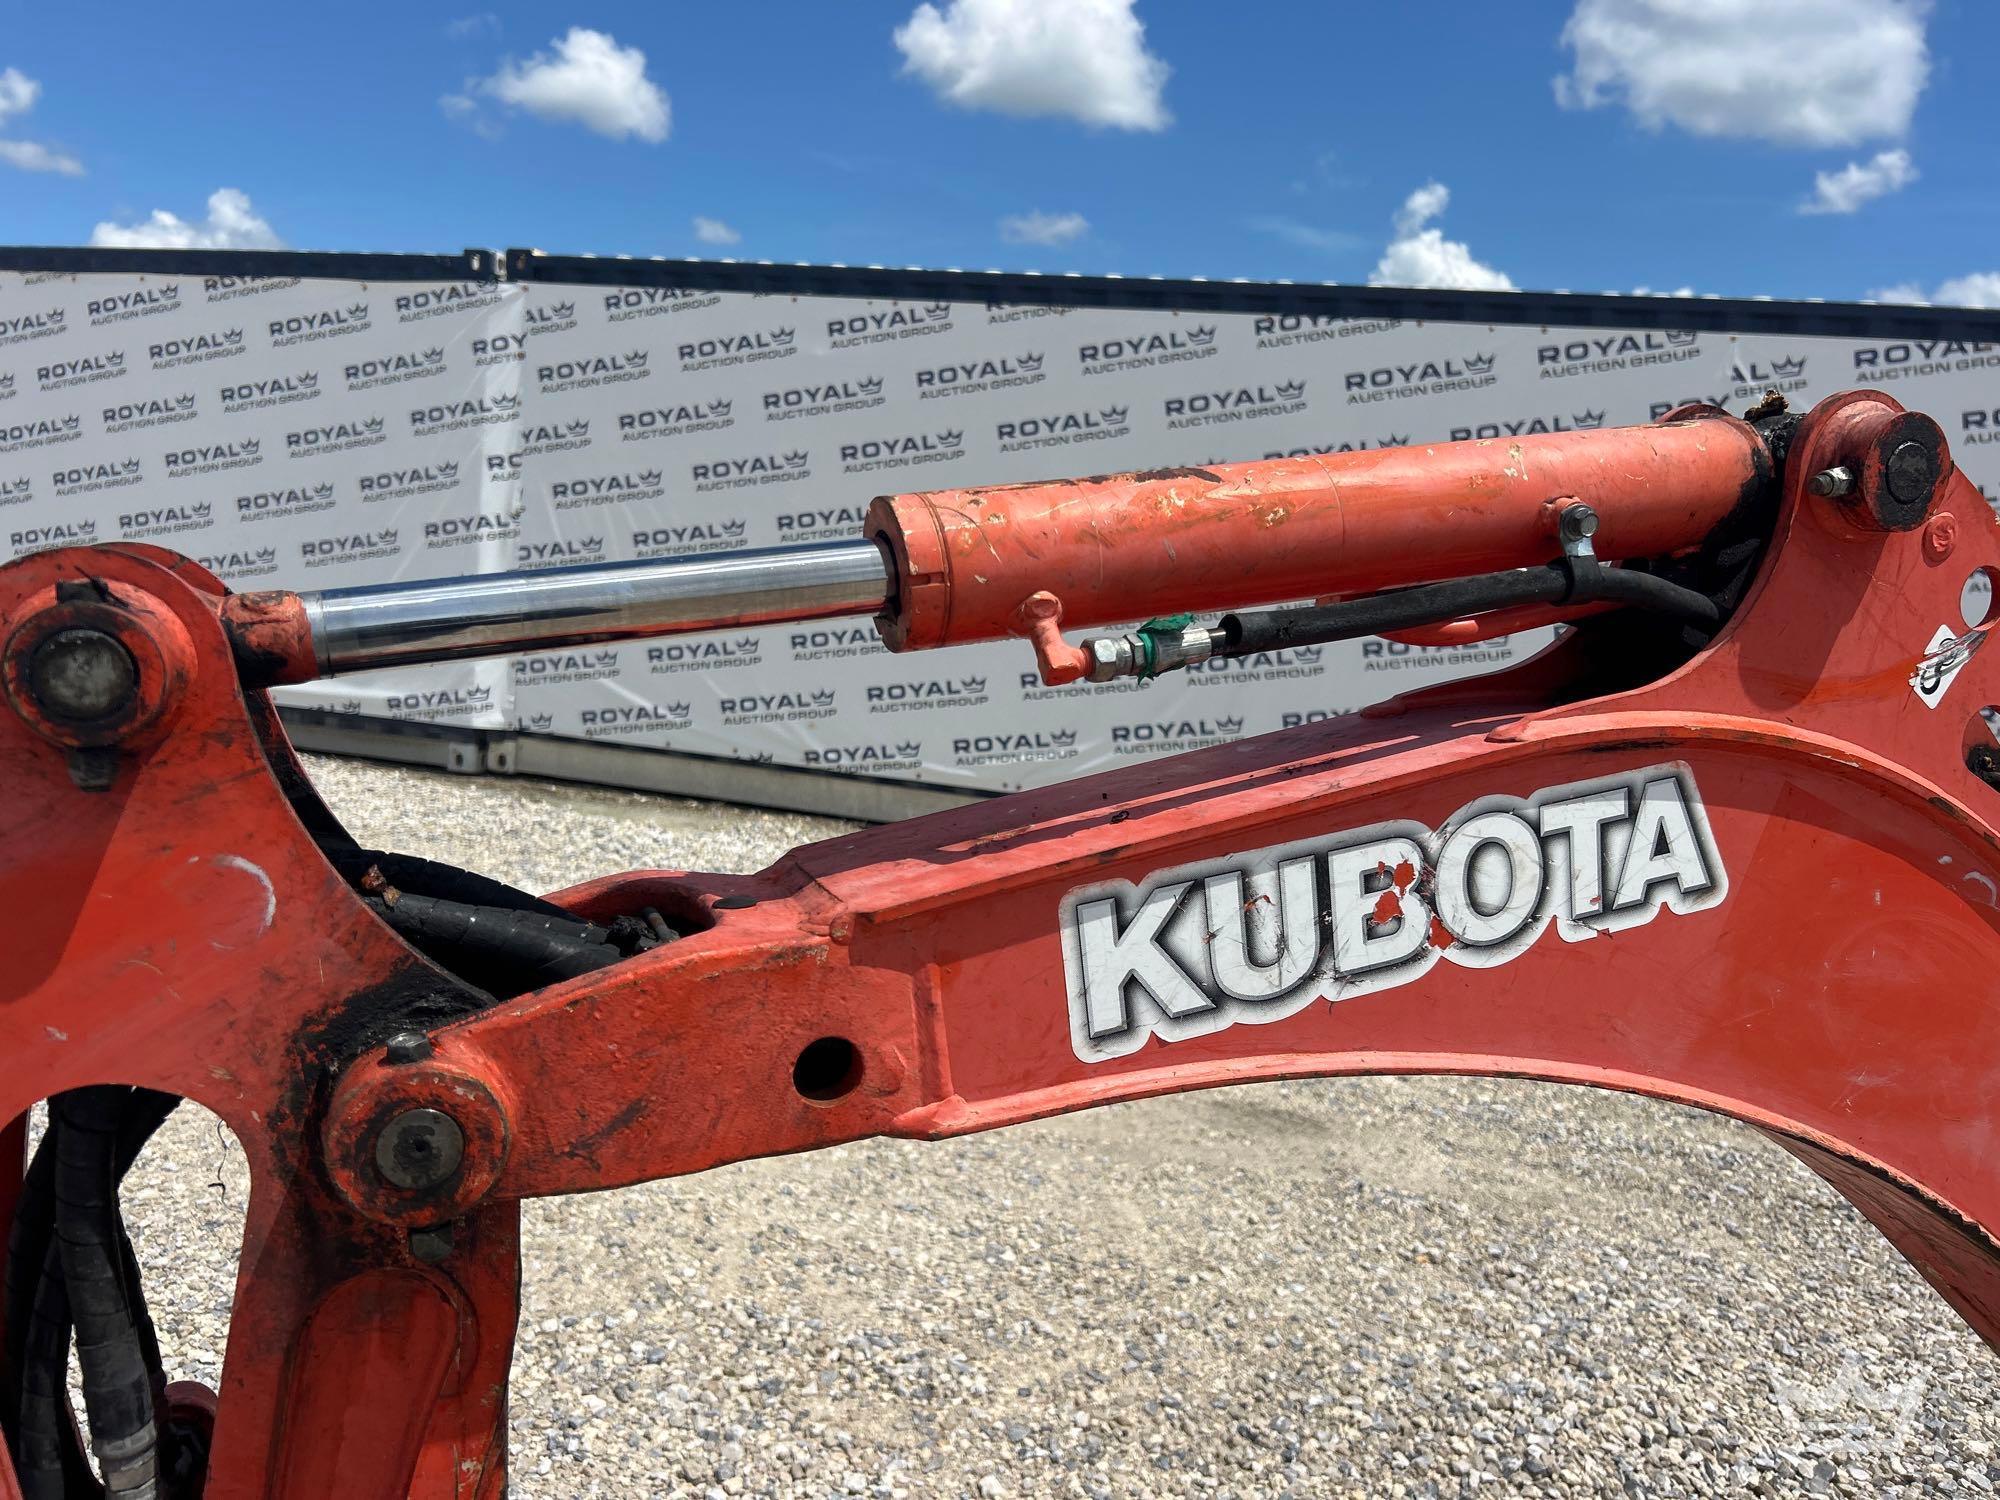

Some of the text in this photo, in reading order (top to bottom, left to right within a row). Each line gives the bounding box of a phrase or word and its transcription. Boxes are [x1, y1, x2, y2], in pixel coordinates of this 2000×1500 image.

[87, 290, 160, 316] ROYAL
[395, 284, 478, 313] ROYAL
[607, 297, 721, 324] AUCTION GROUP
[90, 310, 140, 327] AUCTION
[269, 310, 348, 337] ROYAL
[398, 305, 455, 324] AUCTION
[827, 309, 925, 337] ROYAL
[149, 334, 224, 360] ROYAL
[272, 331, 327, 349] AUCTION
[472, 331, 527, 355] ROY
[678, 333, 770, 361] ROYAL
[830, 323, 954, 350] AUCTION GROUP
[1079, 333, 1187, 363] ROYAL
[1256, 330, 1337, 351] AUCTION
[681, 347, 798, 374] AUCTION GROUP
[1536, 334, 1665, 365] ROYAL
[37, 357, 106, 382] ROYAL
[152, 354, 204, 371] AUCTION
[344, 353, 424, 381] ROYAL
[538, 356, 625, 383] ROYAL
[916, 359, 1017, 388] ROYAL
[1082, 347, 1218, 377] AUCTION GROUP
[1539, 349, 1702, 380] AUCTION GROUP
[1856, 361, 1951, 383] AUCTION
[40, 376, 88, 393] AUCTION
[347, 375, 402, 393] AUCTION
[541, 370, 651, 395] AUCTION GROUP
[919, 374, 1046, 401] AUCTION GROUP
[1345, 361, 1463, 392] ROYAL
[220, 378, 298, 403] ROYAL
[763, 383, 858, 410] ROYAL
[1165, 387, 1275, 417] ROYAL
[1347, 376, 1498, 406] AUCTION GROUP
[102, 399, 176, 424] ROYAL
[224, 398, 277, 415] AUCTION
[410, 400, 492, 426] ROYAL
[619, 405, 708, 431] ROYAL
[766, 397, 886, 423] AUCTION GROUP
[1167, 402, 1308, 431] AUCTION GROUP
[105, 419, 156, 435] AUCTION
[287, 423, 364, 449] ROYAL
[413, 421, 470, 438] AUCTION
[622, 419, 735, 443] AUCTION GROUP
[997, 412, 1100, 441] ROYAL
[289, 443, 343, 460] AUCTION
[840, 435, 937, 462] ROYAL
[999, 427, 1130, 454] AUCTION GROUP
[165, 444, 241, 468] ROYAL
[843, 450, 966, 475] AUCTION GROUP
[52, 463, 122, 487] ROYAL
[168, 464, 220, 479] AUCTION
[359, 467, 438, 493] ROYAL
[692, 456, 784, 481] ROYAL
[55, 482, 103, 498] AUCTION
[552, 475, 639, 499] ROYAL
[695, 470, 811, 494] AUCTION GROUP
[237, 488, 314, 512] ROYAL
[362, 488, 416, 504] AUCTION
[555, 489, 665, 511] AUCTION GROUP
[119, 508, 192, 530] ROYAL
[240, 508, 293, 524] AUCTION
[424, 514, 508, 539] ROYAL
[10, 524, 79, 547] ROYAL
[122, 526, 172, 540] AUCTION
[633, 525, 722, 548] ROYAL
[780, 528, 845, 544] AUCTION
[302, 534, 379, 558] ROYAL
[700, 539, 749, 553] GROUP
[304, 554, 358, 569] AUCTION
[647, 643, 736, 663] ROYAL
[793, 648, 858, 662] AUCTION
[1365, 651, 1512, 673] AUCTION GROUP
[650, 657, 763, 675] AUCTION GROUP
[1188, 667, 1326, 688] AUCTION GROUP
[387, 691, 468, 712] ROYAL
[867, 681, 961, 703] ROYAL
[1022, 687, 1093, 702] AUCTION
[581, 706, 668, 726] ROYAL
[720, 694, 811, 715] ROYAL
[869, 696, 989, 715] AUCTION GROUP
[584, 721, 694, 736] AUCTION GROUP
[723, 709, 838, 727] AUCTION GROUP
[1112, 721, 1216, 743] ROYAL
[803, 745, 896, 766] ROYAL
[953, 734, 1050, 755] ROYAL
[1114, 742, 1187, 756] AUCTION
[1077, 776, 1712, 1039] KUBOTA
